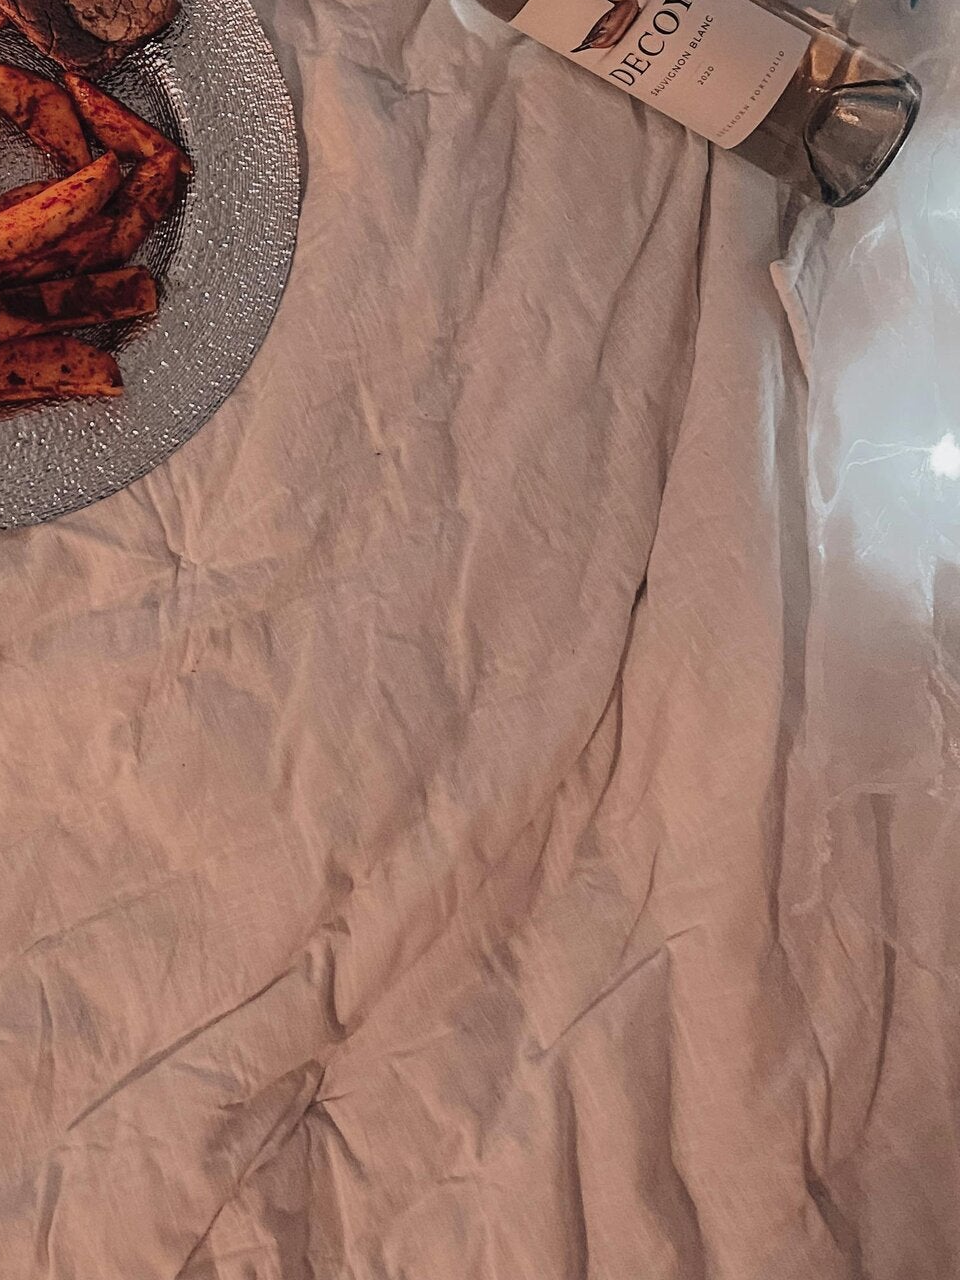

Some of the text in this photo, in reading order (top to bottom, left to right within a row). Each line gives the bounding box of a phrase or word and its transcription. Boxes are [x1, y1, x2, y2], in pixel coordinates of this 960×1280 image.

[650, 14, 715, 98] SAUVIGNON BLANC
[696, 65, 716, 86] 2020
[750, 50, 786, 102] PORTFOLIO
